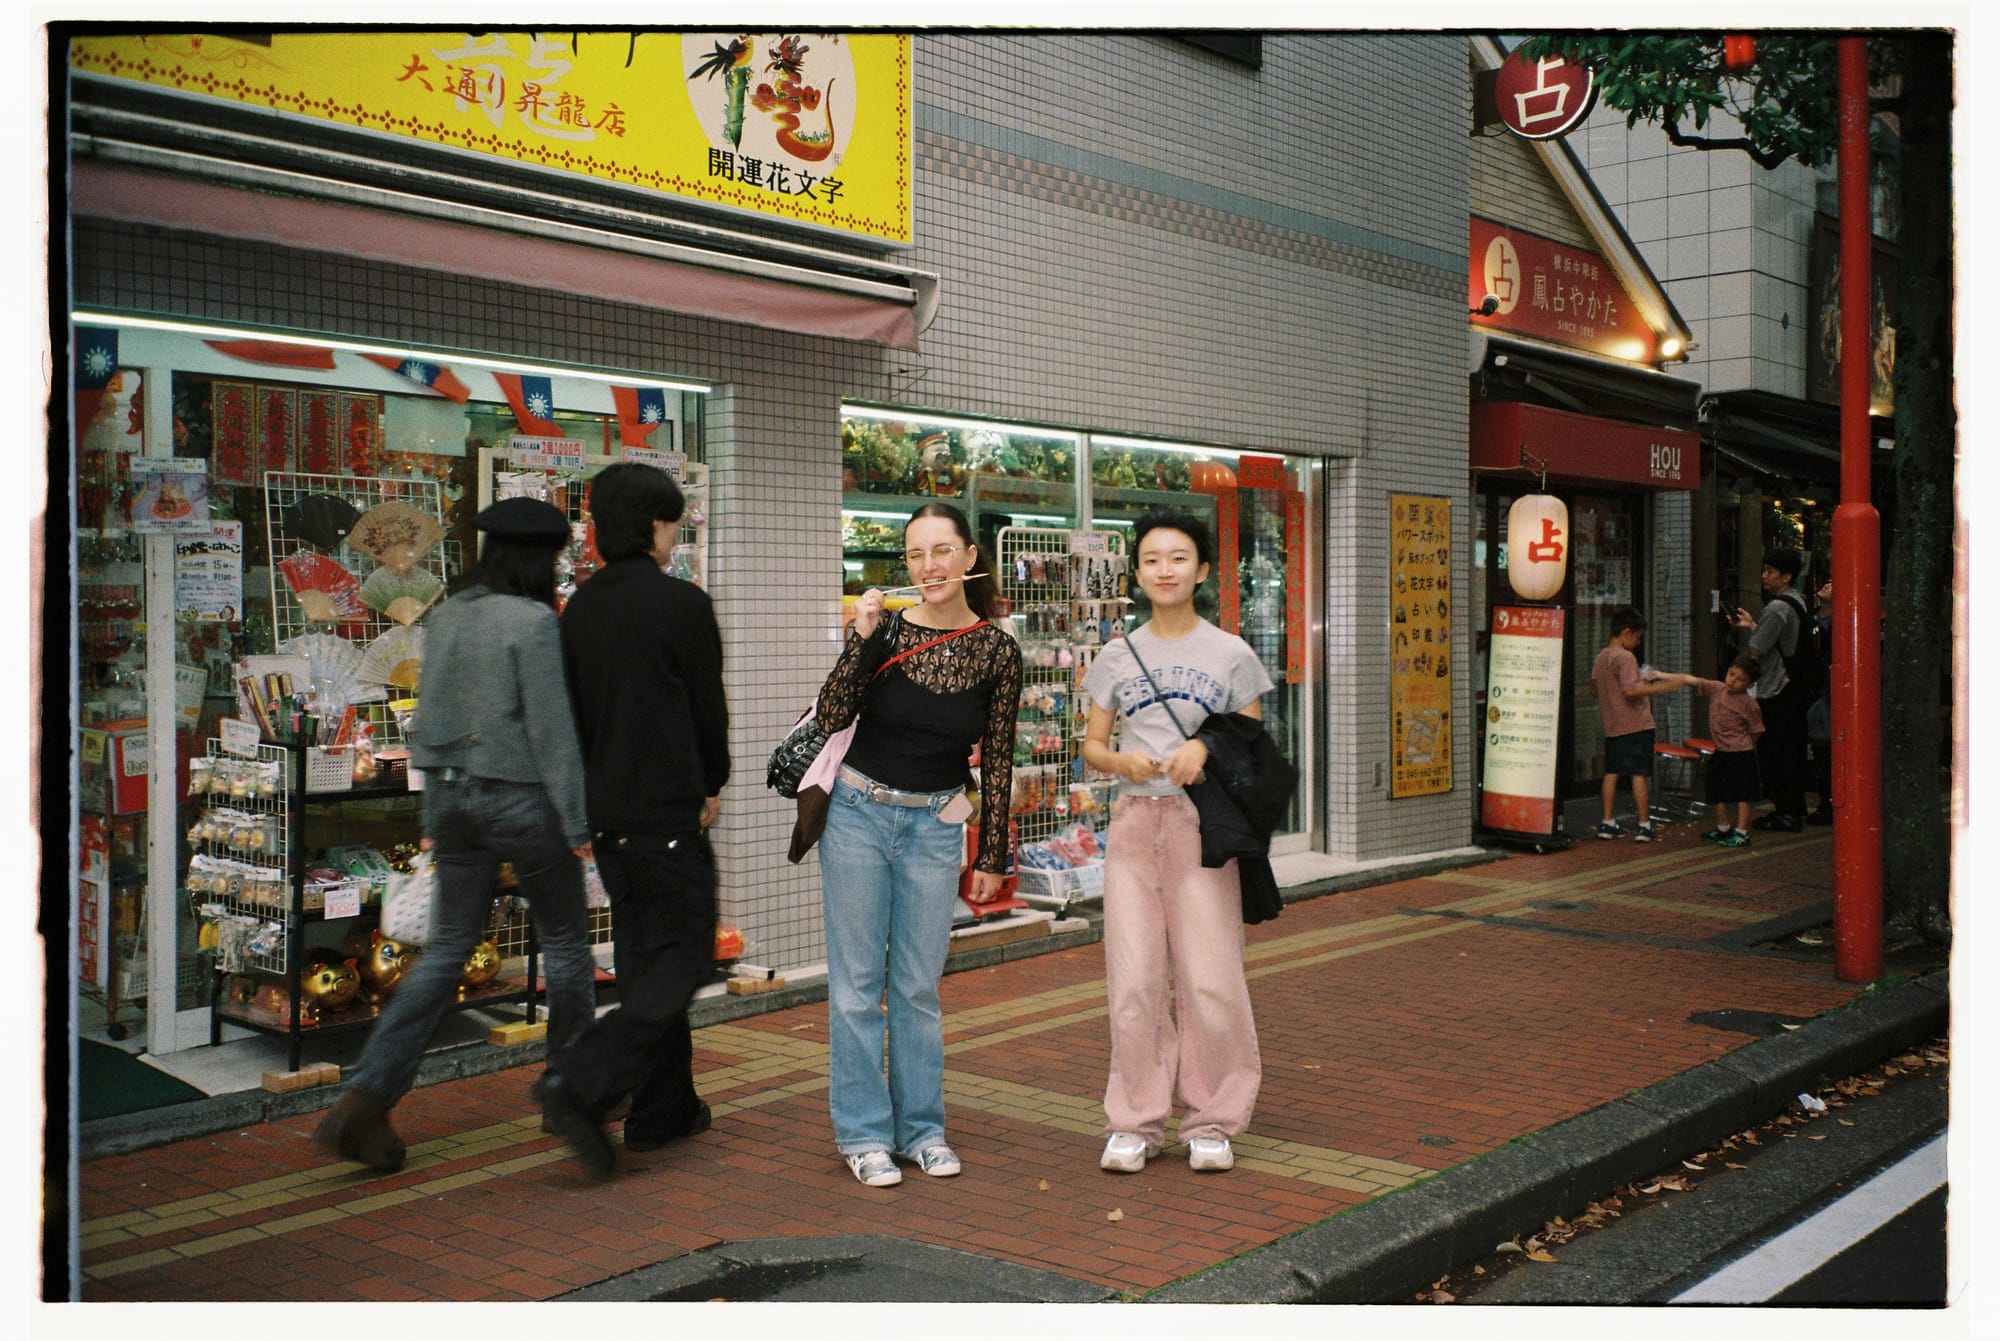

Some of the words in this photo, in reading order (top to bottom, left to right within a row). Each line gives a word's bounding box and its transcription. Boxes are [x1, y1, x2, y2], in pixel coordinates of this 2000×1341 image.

[396, 54, 627, 138] 大通り昇龍店
[1513, 56, 1571, 128] 占
[707, 147, 845, 205] 開運花文字
[1492, 243, 1513, 302] 占
[1558, 319, 1577, 334] SINCE
[1651, 444, 1680, 470] HOU
[1397, 528, 1446, 544] パワースポット
[1528, 518, 1564, 563] 占
[1410, 576, 1435, 591] 花文字
[1412, 602, 1433, 617] 占い
